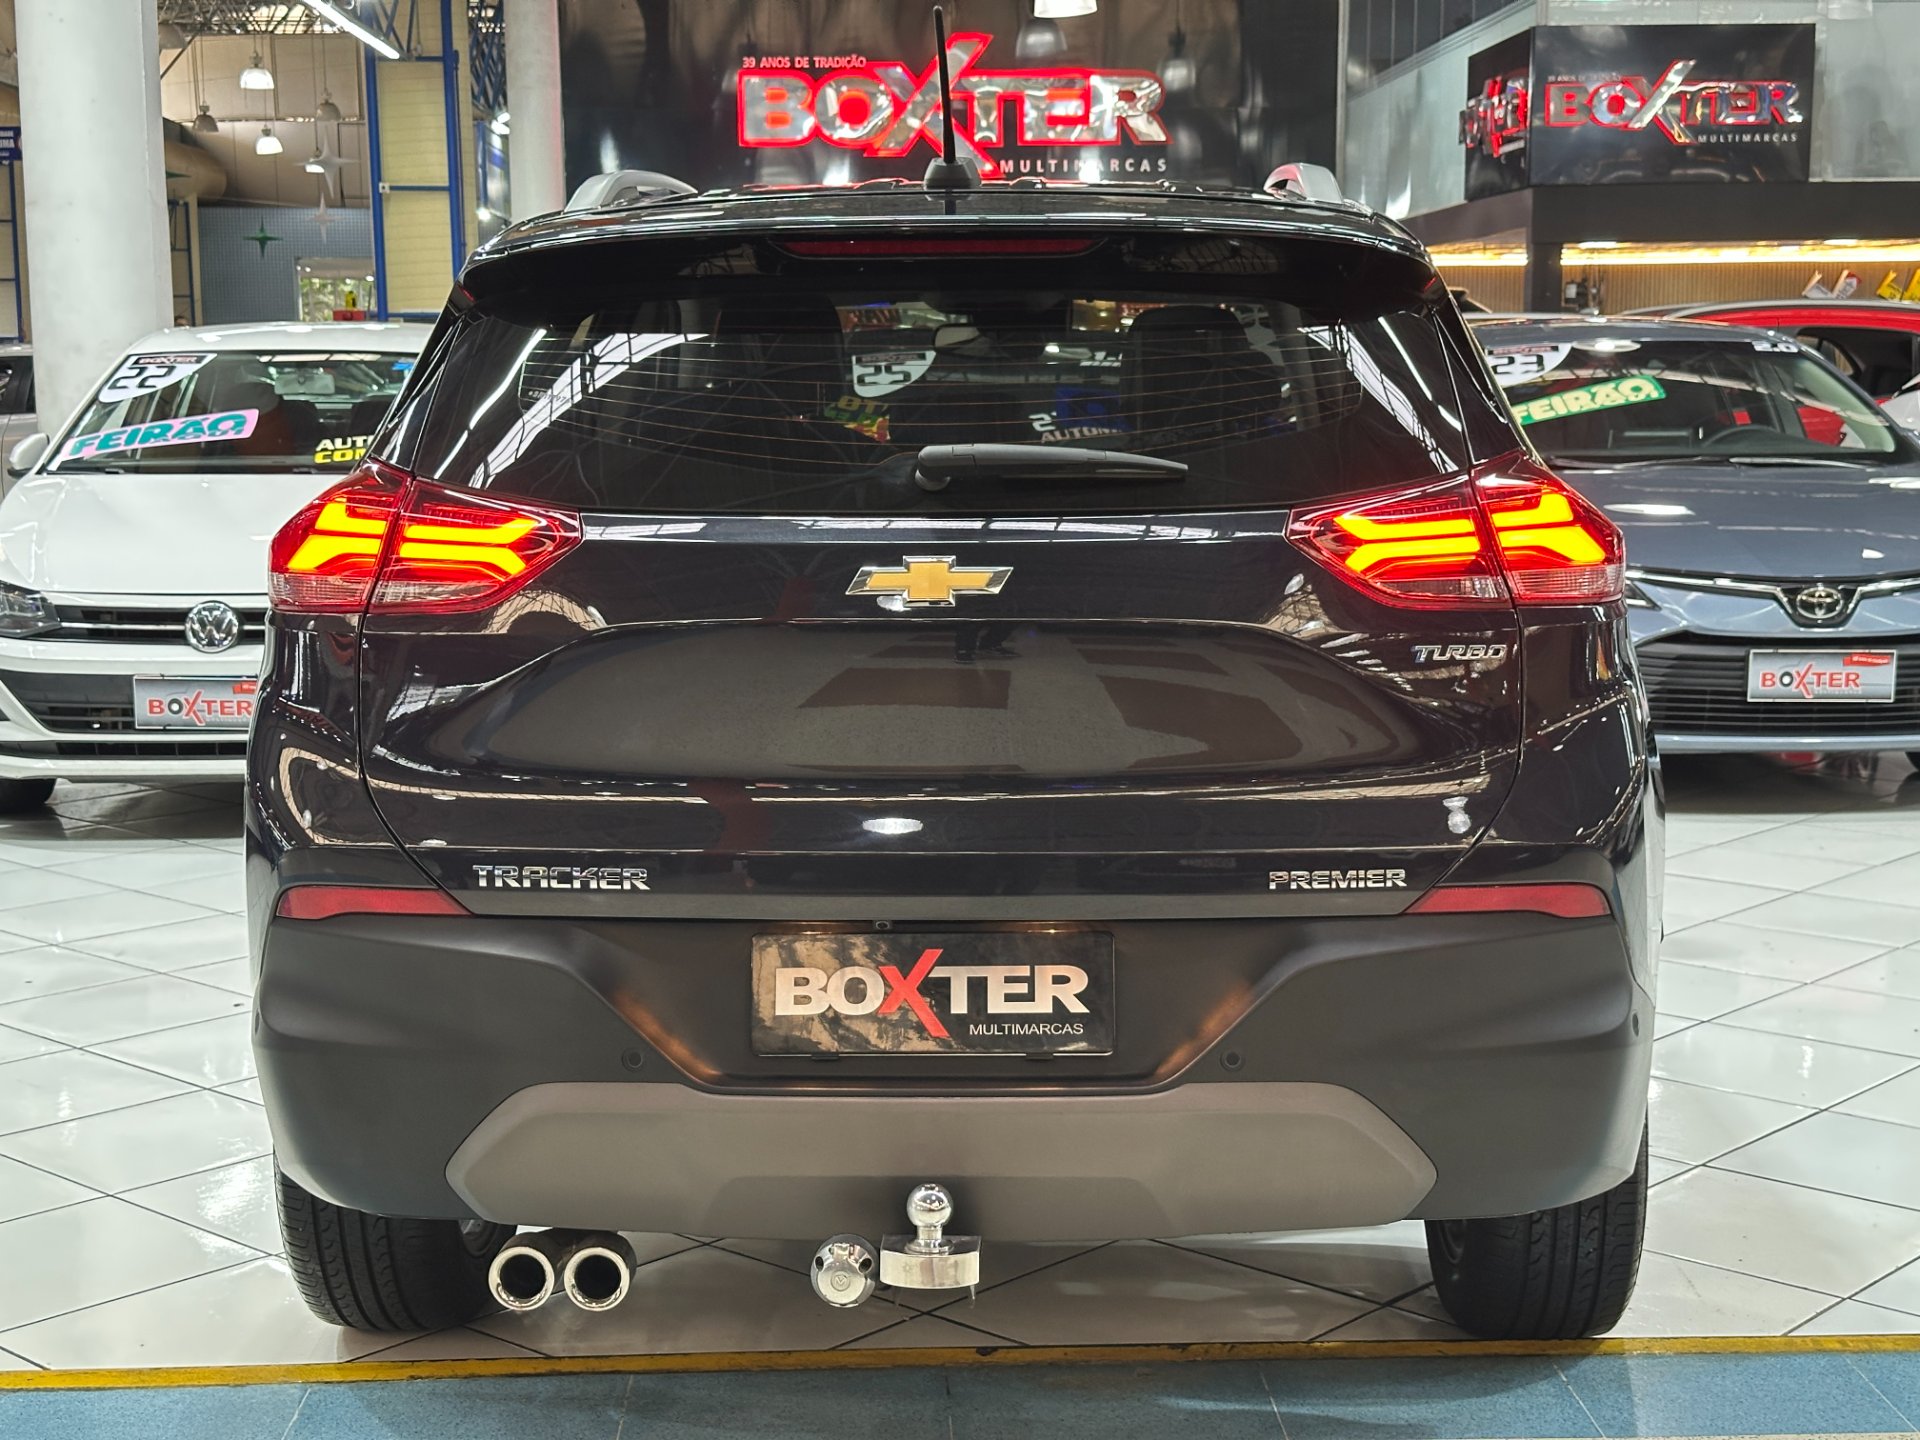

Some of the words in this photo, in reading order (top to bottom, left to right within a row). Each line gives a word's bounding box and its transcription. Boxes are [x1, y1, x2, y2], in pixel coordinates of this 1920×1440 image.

[742, 56, 756, 69] 39
[760, 56, 791, 69] ANOS
[795, 56, 810, 69] DE
[813, 53, 867, 70] TRADIÇÃO
[737, 32, 1175, 177] BOXTER
[1545, 58, 1803, 146] BOXTER
[1698, 133, 1798, 144] MULTIMARCAS
[1491, 354, 1546, 374] 23
[107, 365, 177, 390] 22
[69, 413, 247, 456] FEIRÃO
[1411, 644, 1507, 663] TURBO
[1759, 662, 1862, 699] BOXTER
[148, 688, 254, 726] BOXTER
[472, 864, 651, 891] TRACKER
[1268, 868, 1408, 891] PREMIER
[774, 948, 1091, 1039] BOXTER
[968, 1022, 1085, 1036] MULTIMARCAS
